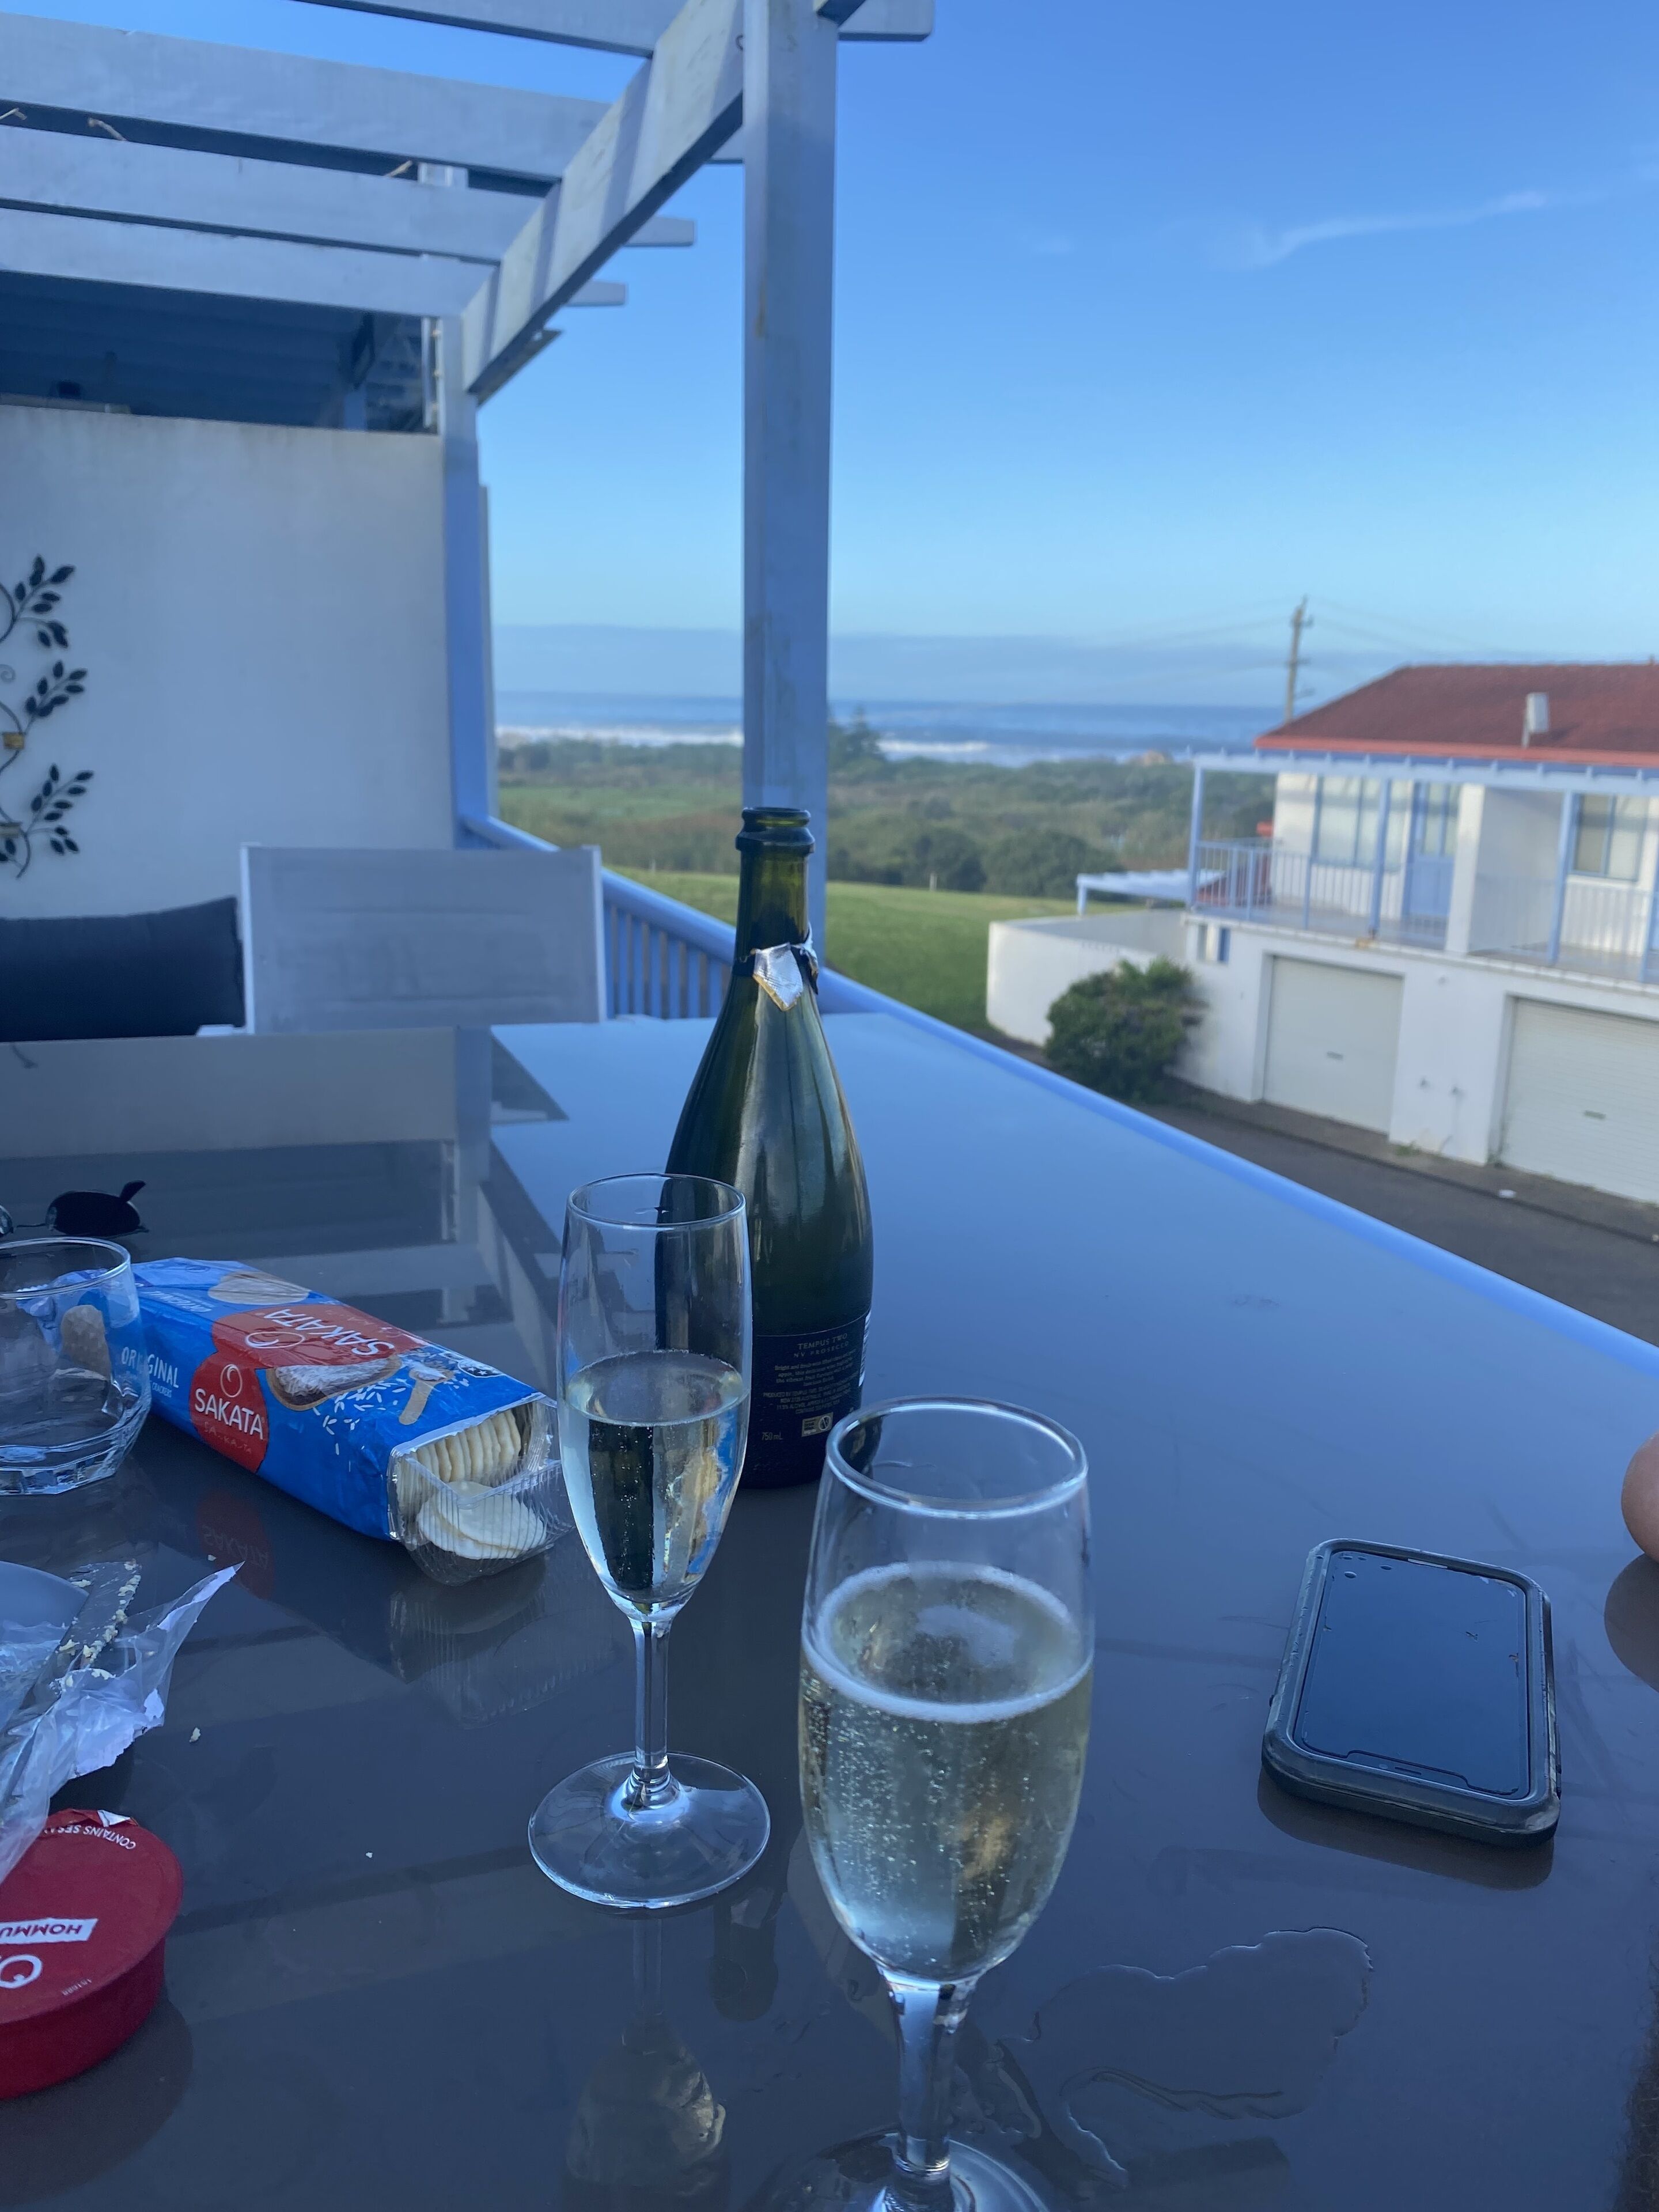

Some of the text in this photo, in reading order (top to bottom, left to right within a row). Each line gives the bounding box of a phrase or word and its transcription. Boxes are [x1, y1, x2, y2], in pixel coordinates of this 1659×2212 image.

[263, 1308, 395, 1356] SAKATA
[797, 1332, 849, 1350] TEMPUS TWO
[121, 1346, 179, 1388] ORIGINAL
[195, 1388, 264, 1441] SAKATA
[82, 1825, 137, 1850] CONTAINS
